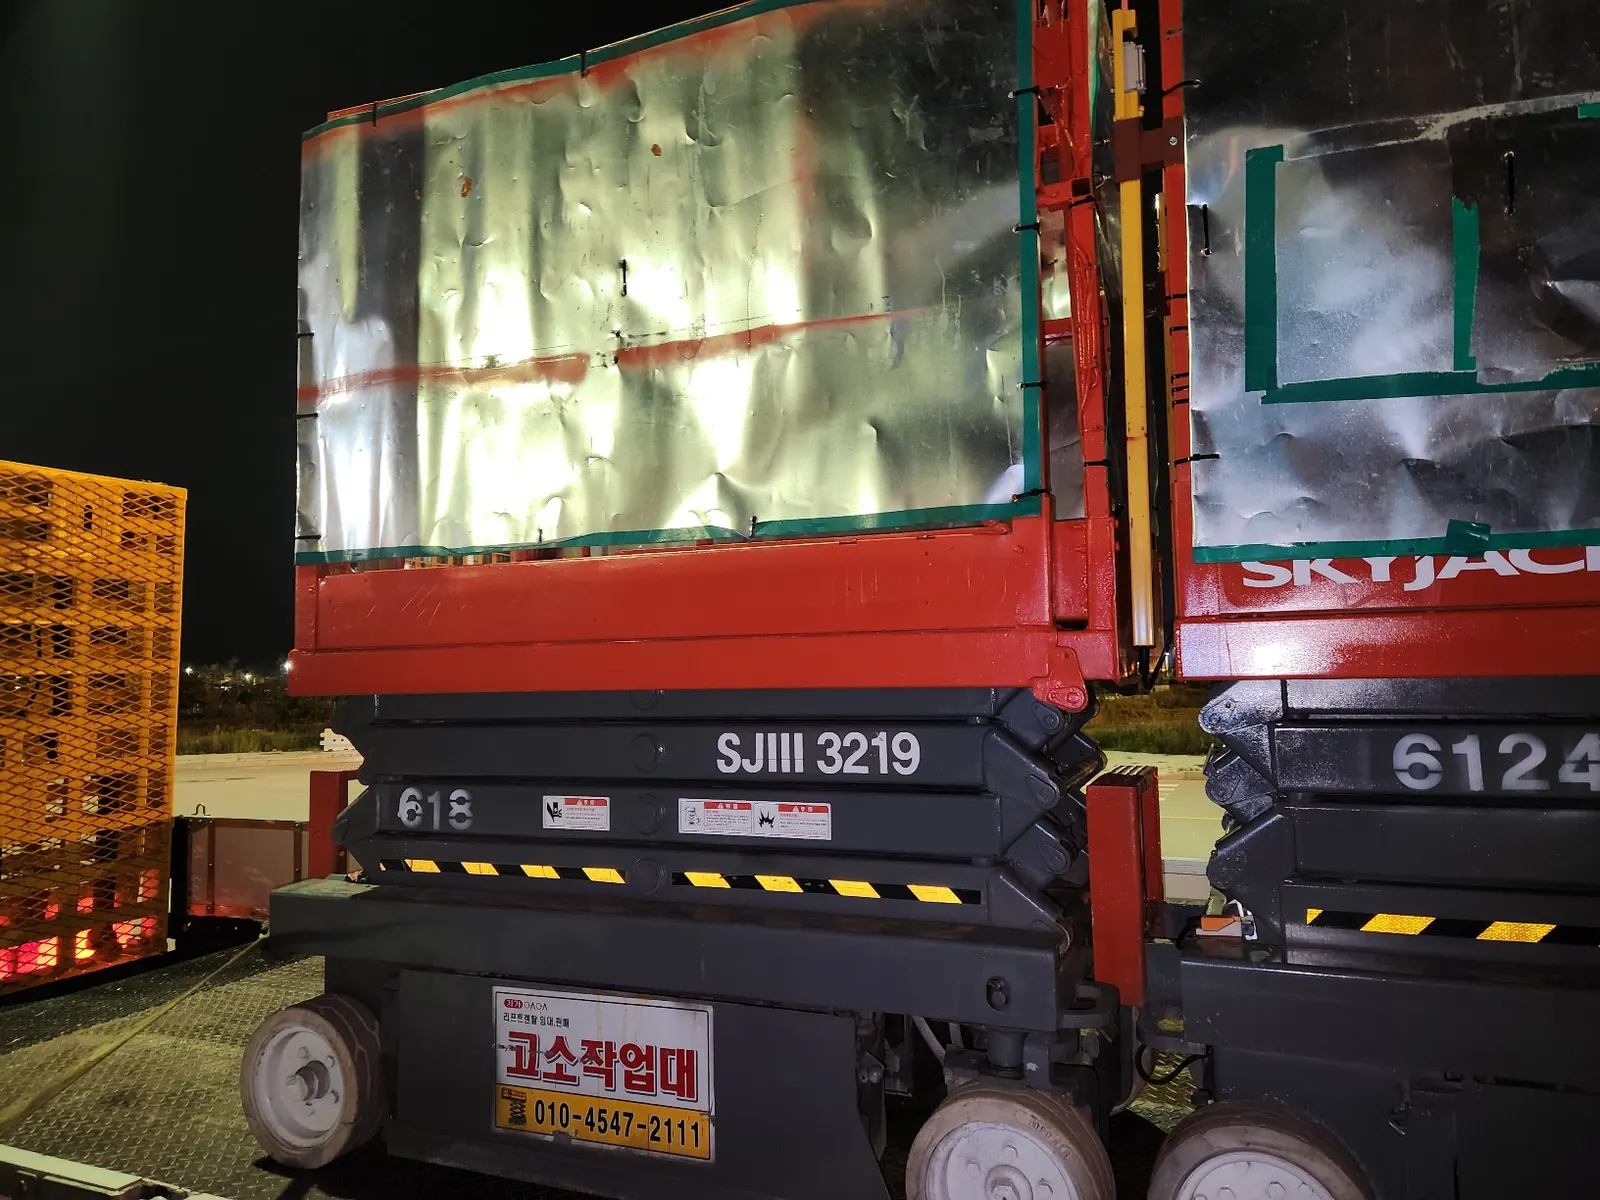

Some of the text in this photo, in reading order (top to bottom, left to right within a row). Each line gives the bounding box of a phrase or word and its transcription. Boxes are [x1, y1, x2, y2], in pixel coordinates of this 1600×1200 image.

[1241, 546, 1600, 591] SKYJAC
[816, 731, 921, 775] 3219
[1392, 732, 1600, 791] 6124
[397, 786, 474, 831] 618
[506, 1031, 698, 1102] 고소작업대
[534, 1099, 700, 1148] 010-4547-2111
